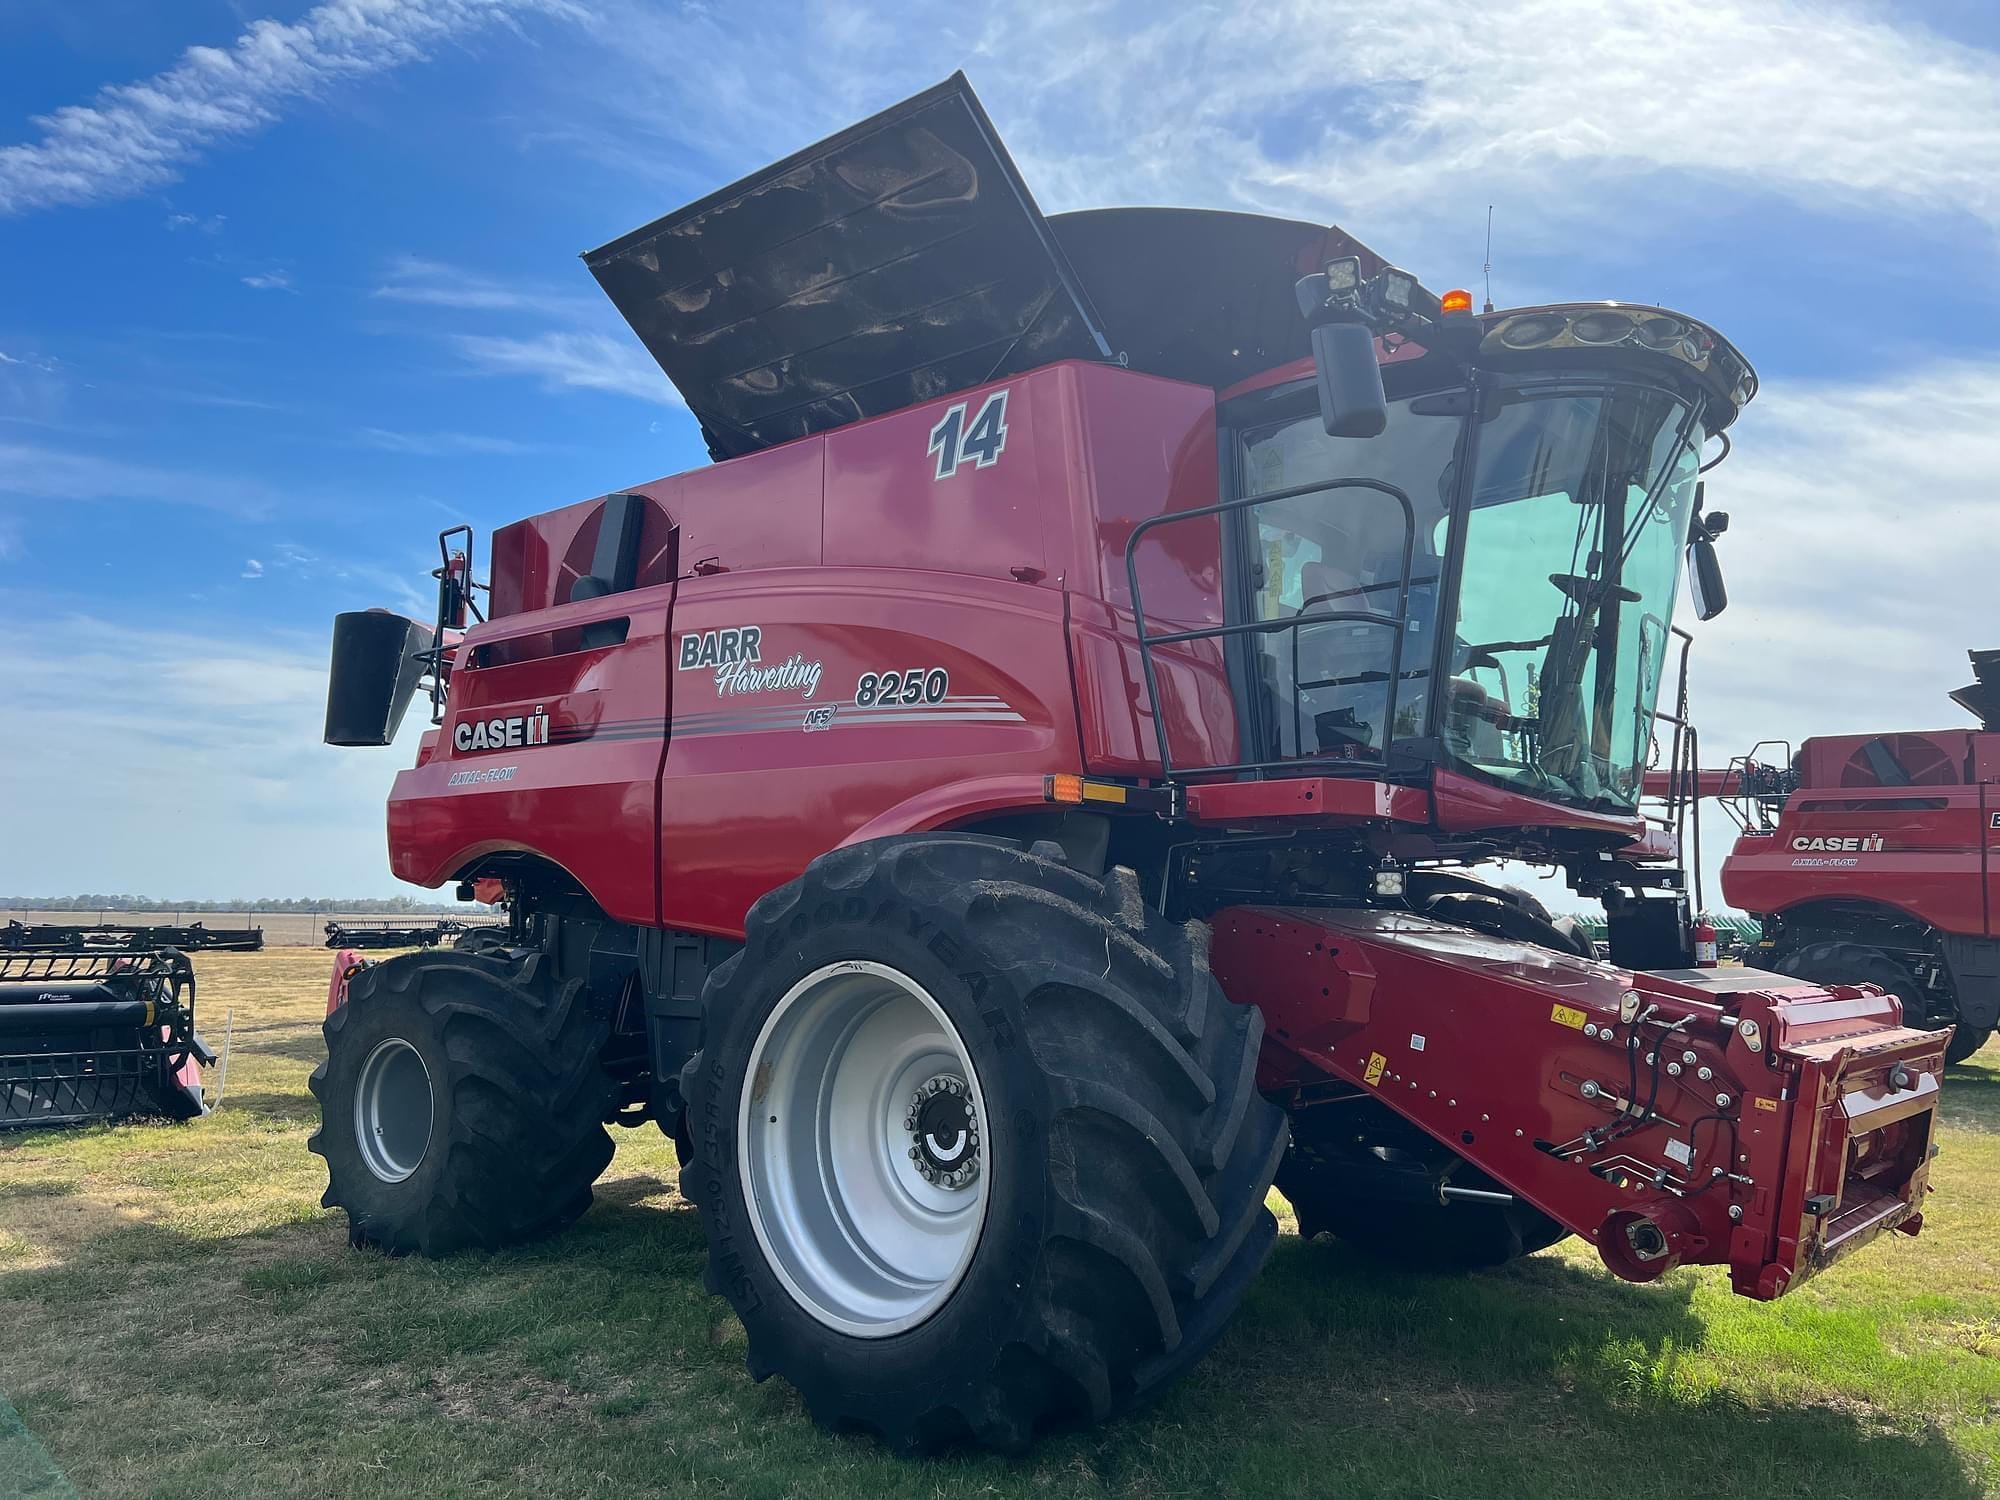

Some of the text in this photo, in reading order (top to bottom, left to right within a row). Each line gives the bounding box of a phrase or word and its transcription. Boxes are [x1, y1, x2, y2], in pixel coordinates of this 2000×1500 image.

[927, 388, 1010, 481] 14
[679, 626, 762, 670] BARR
[714, 651, 822, 699] Harvesting
[855, 667, 949, 709] 8250
[454, 717, 523, 751] CASE
[448, 766, 517, 787] AXIAL-FLOW
[1791, 858, 1858, 867] AXIAL-FLOW
[1792, 836, 1859, 852] CASE
